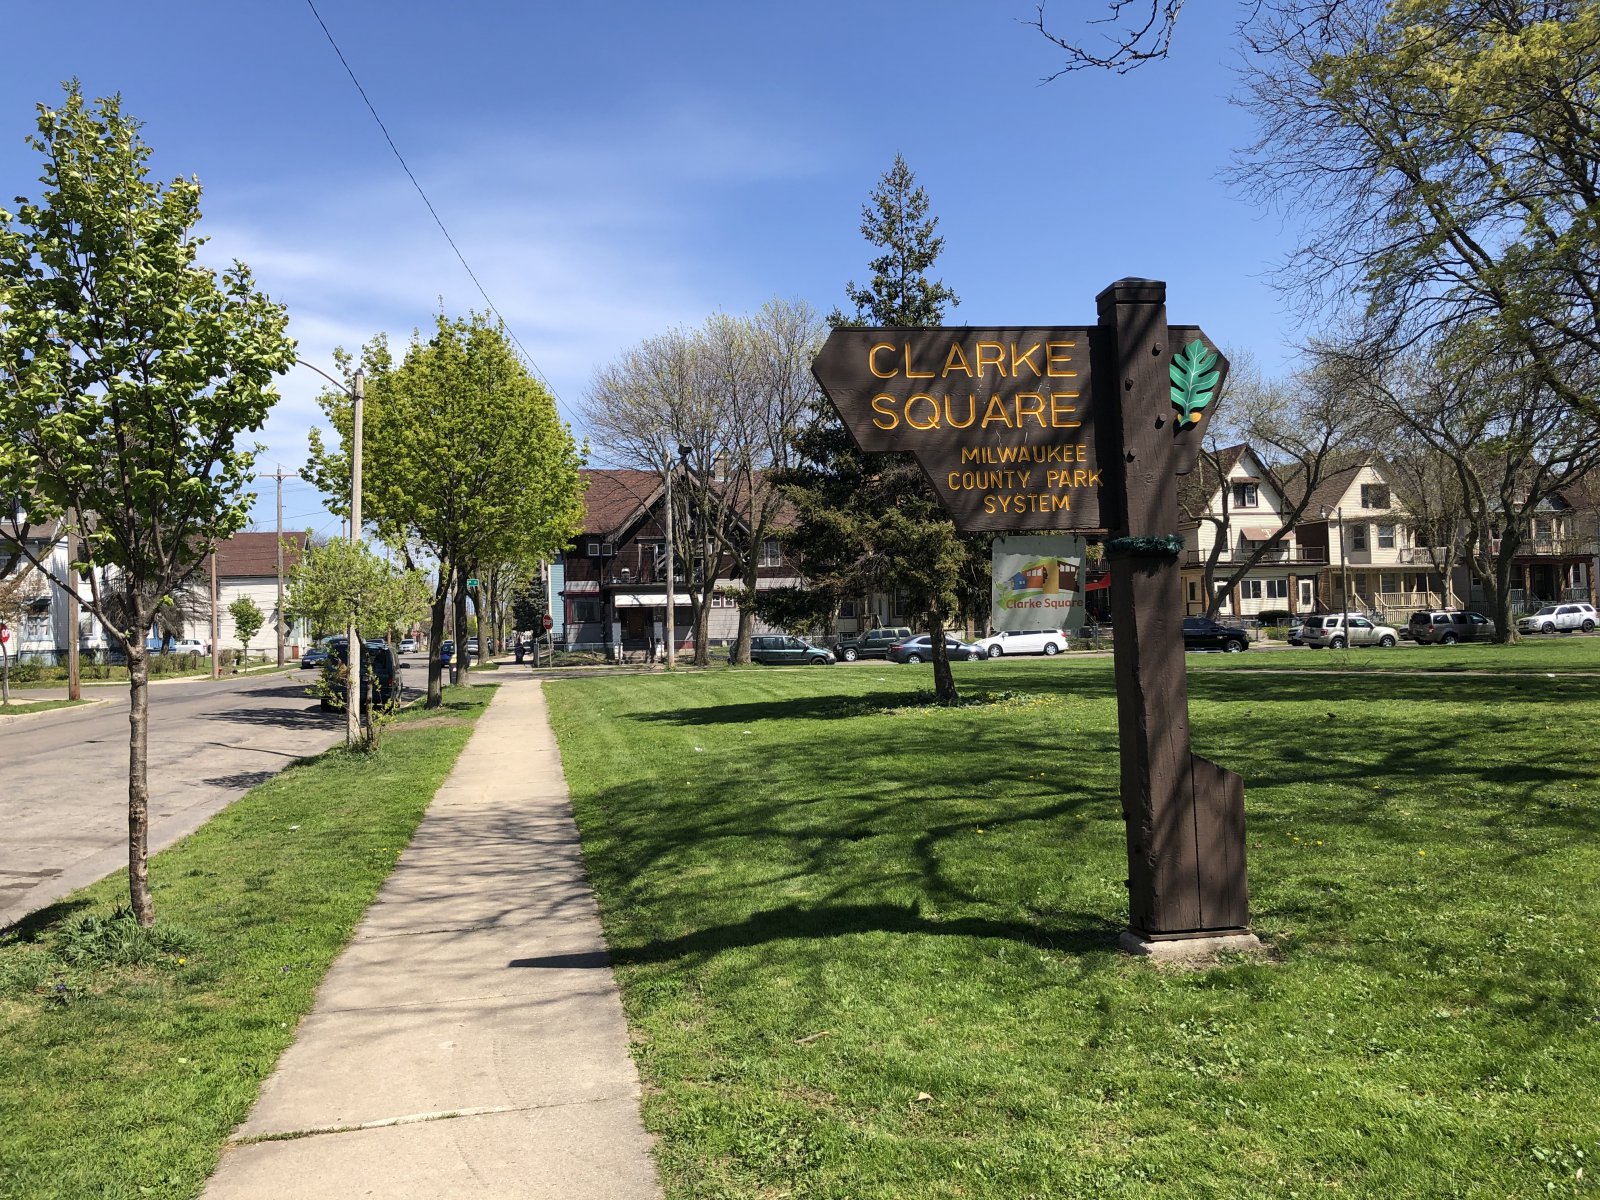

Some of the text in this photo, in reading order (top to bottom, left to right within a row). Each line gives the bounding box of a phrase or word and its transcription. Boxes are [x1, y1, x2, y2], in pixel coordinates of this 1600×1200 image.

[868, 341, 1078, 379] CLARKE
[871, 392, 1082, 430] SQUARE
[961, 443, 1088, 465] MILWAUKEE
[948, 468, 1104, 491] COUNTY PARK
[983, 493, 1071, 514] SYSTEM
[1006, 598, 1084, 609] Clarke Square
